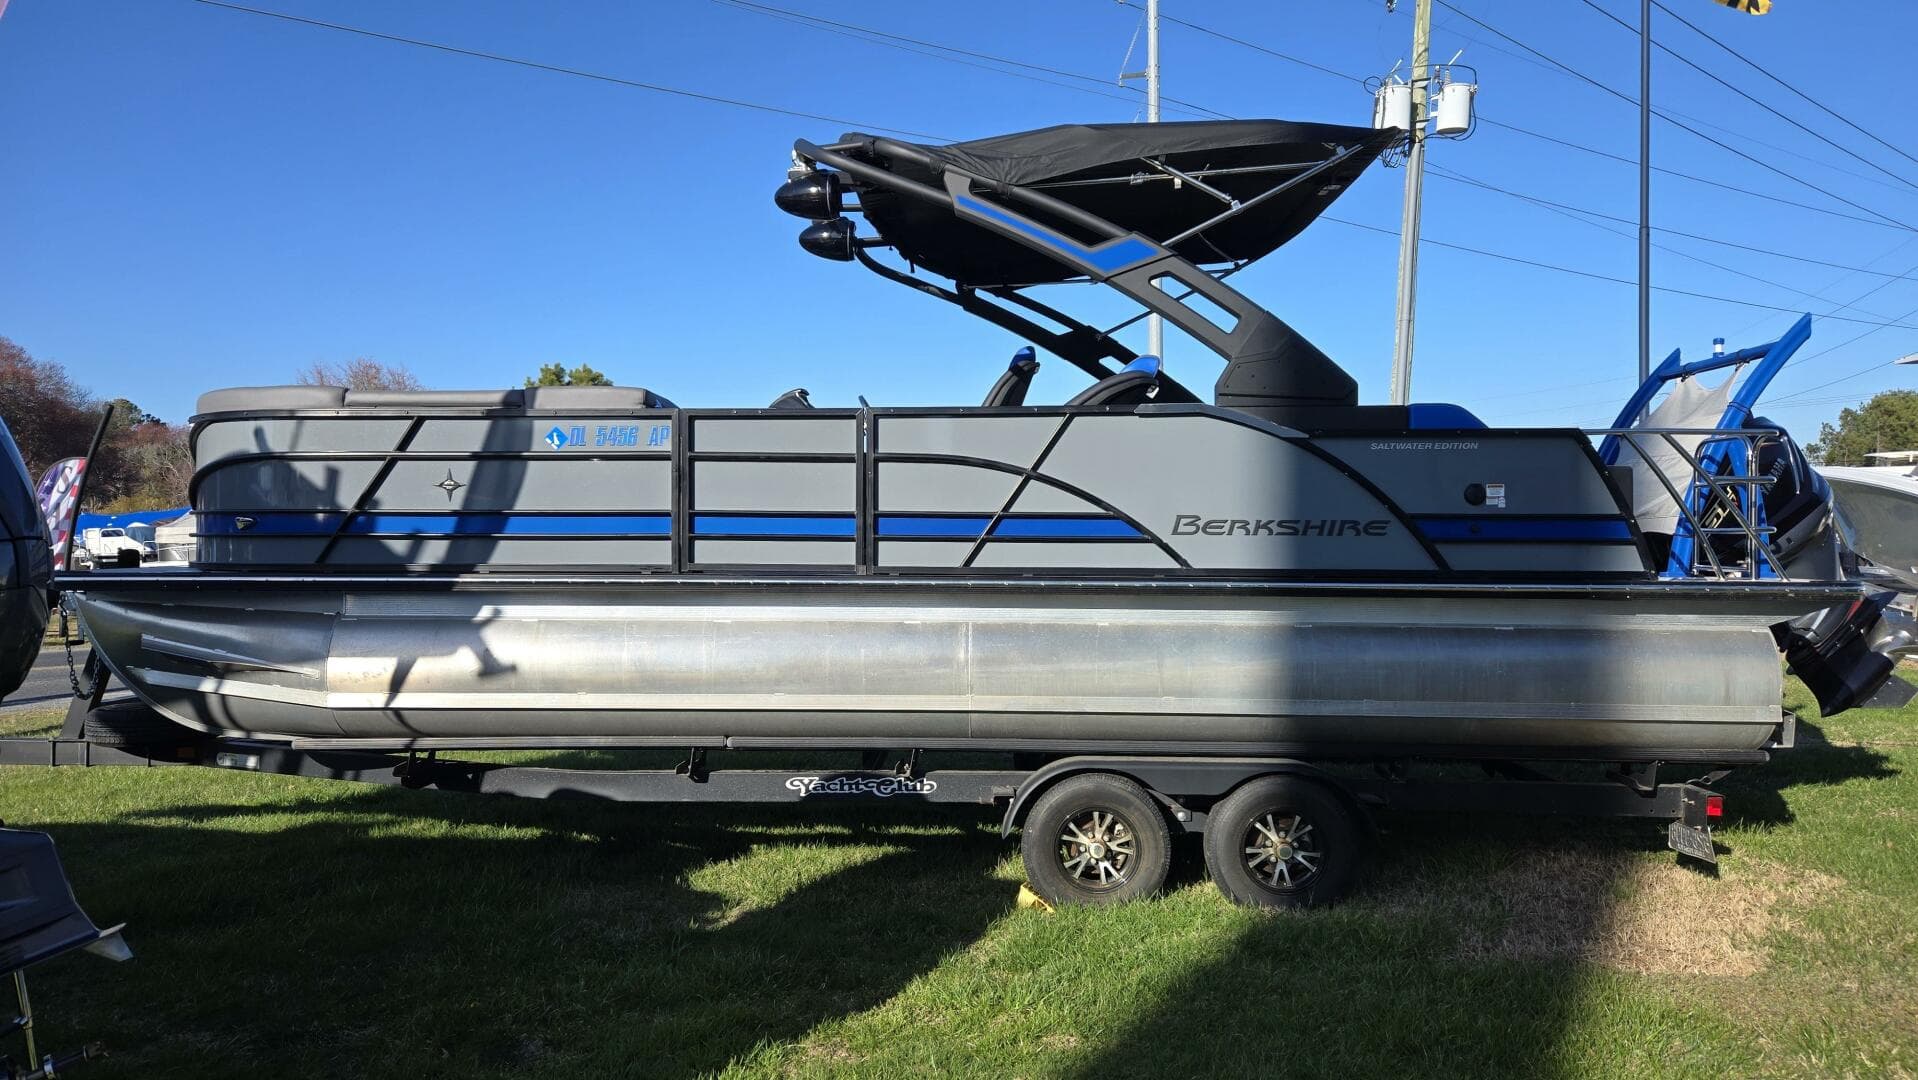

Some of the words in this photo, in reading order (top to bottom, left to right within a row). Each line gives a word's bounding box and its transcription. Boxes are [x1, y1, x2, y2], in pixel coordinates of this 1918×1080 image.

[568, 425, 587, 447] DL
[595, 425, 639, 447] 5456
[648, 425, 671, 447] AP
[1370, 442, 1433, 450] SALTWATER
[1433, 442, 1479, 450] EDITION
[1759, 457, 1785, 496] YAAHA
[1171, 514, 1392, 537] BERKSHIRE
